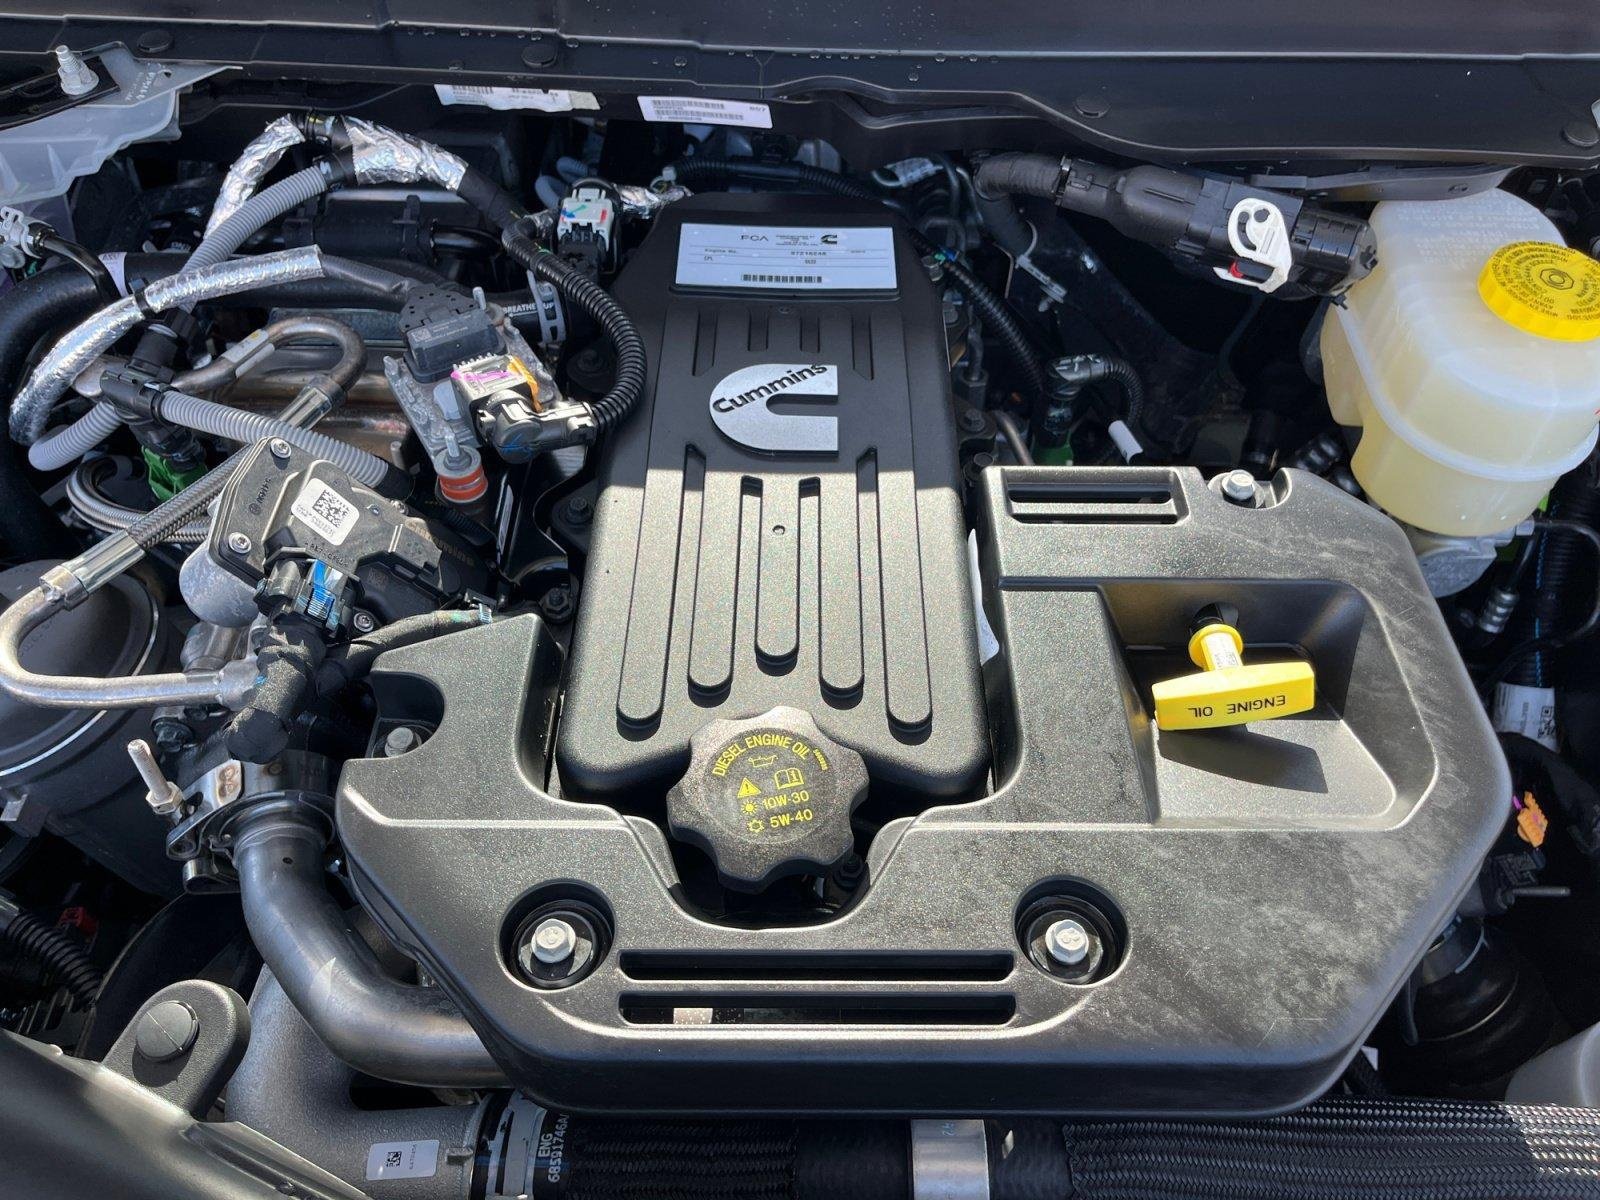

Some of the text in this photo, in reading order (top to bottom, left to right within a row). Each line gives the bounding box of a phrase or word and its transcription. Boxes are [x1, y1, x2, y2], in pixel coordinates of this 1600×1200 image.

[712, 363, 828, 413] Cummins
[1188, 695, 1286, 718] ENGINE OIL
[712, 743, 746, 776] DIESEL
[745, 734, 793, 749] ENGINE
[792, 741, 810, 760] OIL
[762, 790, 809, 810] 10W-30
[769, 808, 813, 828] 5W-40
[537, 1132, 553, 1158] ENG
